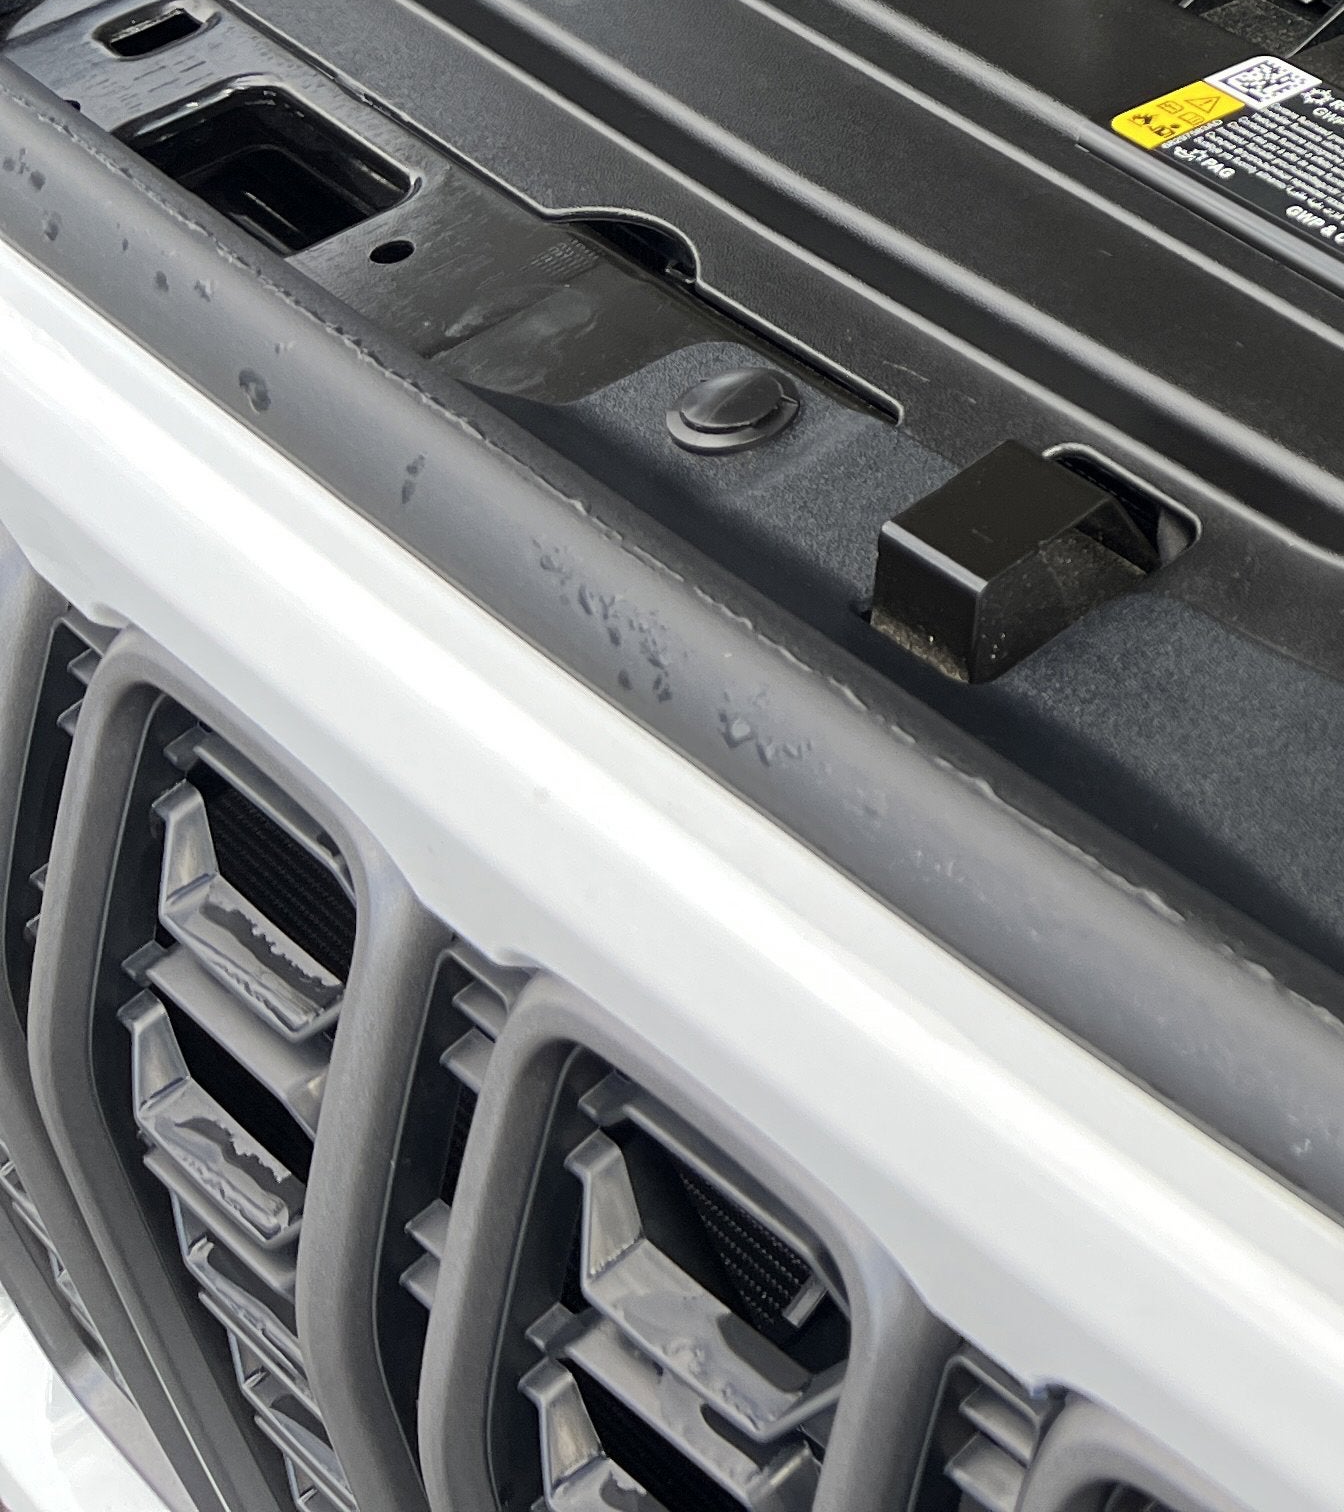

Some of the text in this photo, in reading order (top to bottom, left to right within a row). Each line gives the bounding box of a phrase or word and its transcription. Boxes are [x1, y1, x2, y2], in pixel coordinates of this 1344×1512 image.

[1201, 158, 1235, 178] PAG
[1286, 206, 1325, 227] GWP
[1320, 225, 1337, 237] &
